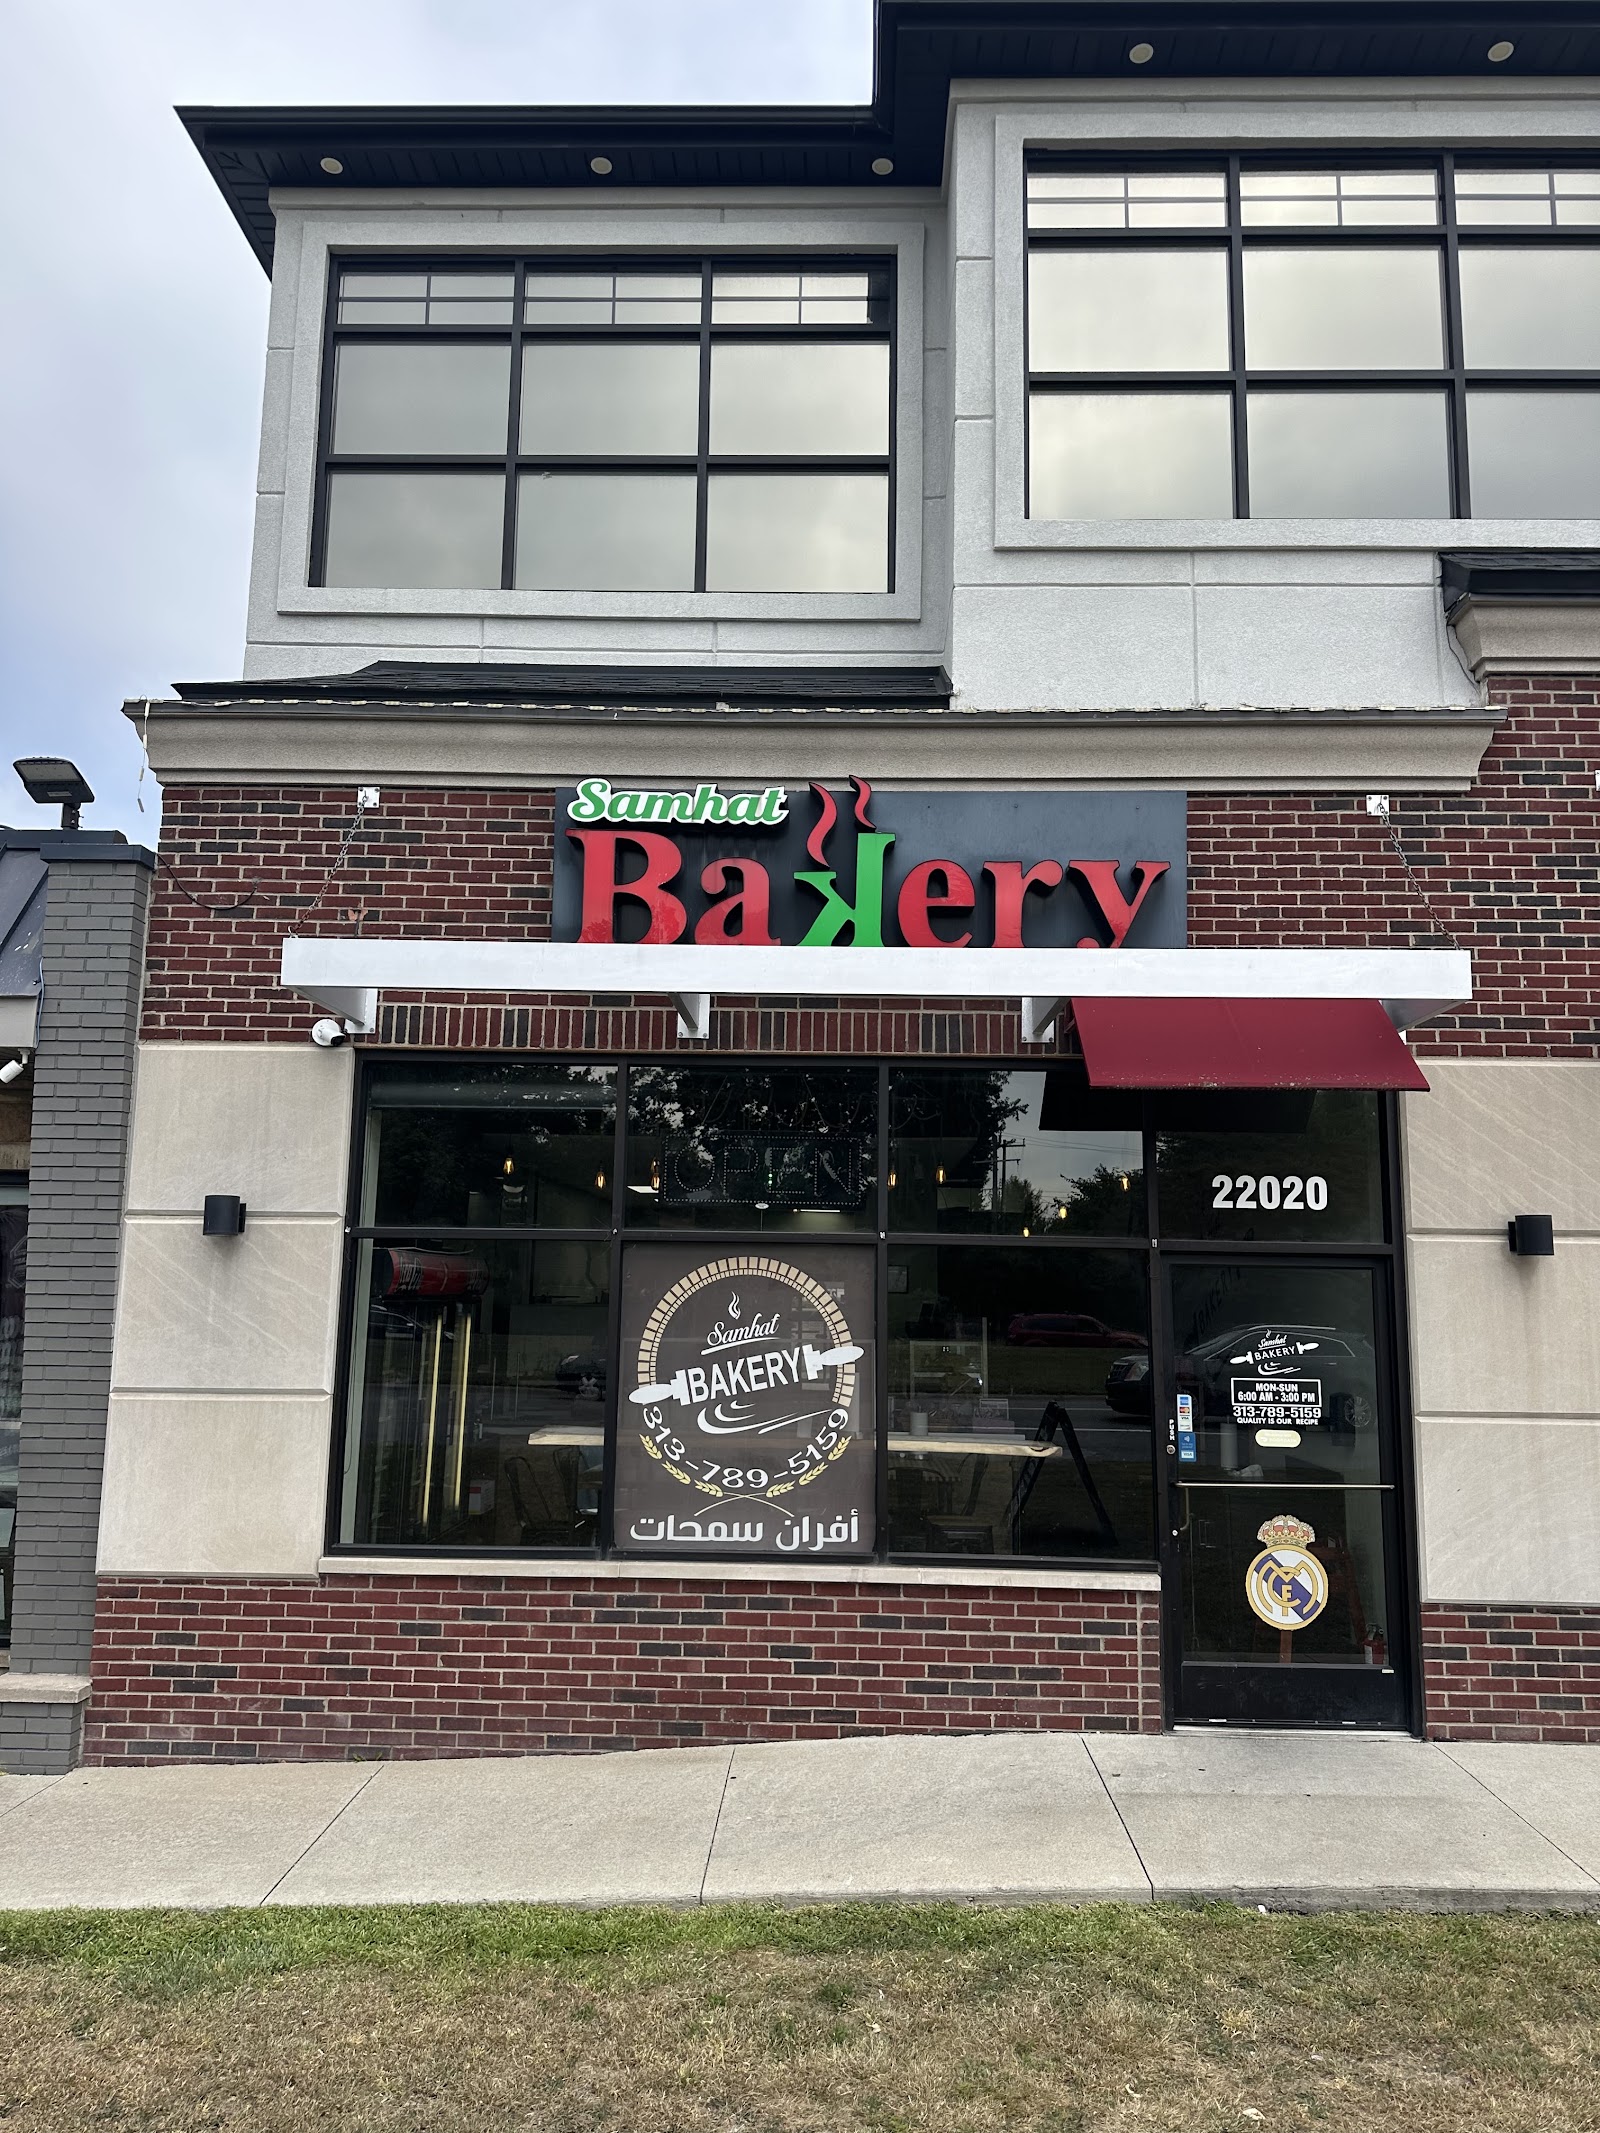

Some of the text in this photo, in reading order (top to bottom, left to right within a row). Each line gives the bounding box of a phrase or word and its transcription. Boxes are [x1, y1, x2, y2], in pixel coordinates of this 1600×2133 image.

[566, 777, 789, 826] Samhat
[565, 828, 1172, 948] Bakery
[674, 1144, 852, 1199] OPEN
[1212, 1174, 1328, 1211] 22020
[707, 1313, 780, 1346] Samhat
[1258, 1334, 1287, 1348] Samhat
[1254, 1346, 1295, 1361] BAKERY
[687, 1347, 800, 1404] BAKERY
[1255, 1383, 1299, 1392] MON-SUN
[1233, 1406, 1322, 1418] 313-789-5159
[1238, 1391, 1257, 1402] 6:00
[1259, 1392, 1274, 1402] AM
[1280, 1392, 1300, 1402] 3:00
[1301, 1392, 1316, 1403] PM
[1236, 1417, 1266, 1425] QUALITY
[643, 1406, 849, 1488] 313-789-5159
[630, 1508, 859, 1551] أفران سمحات
